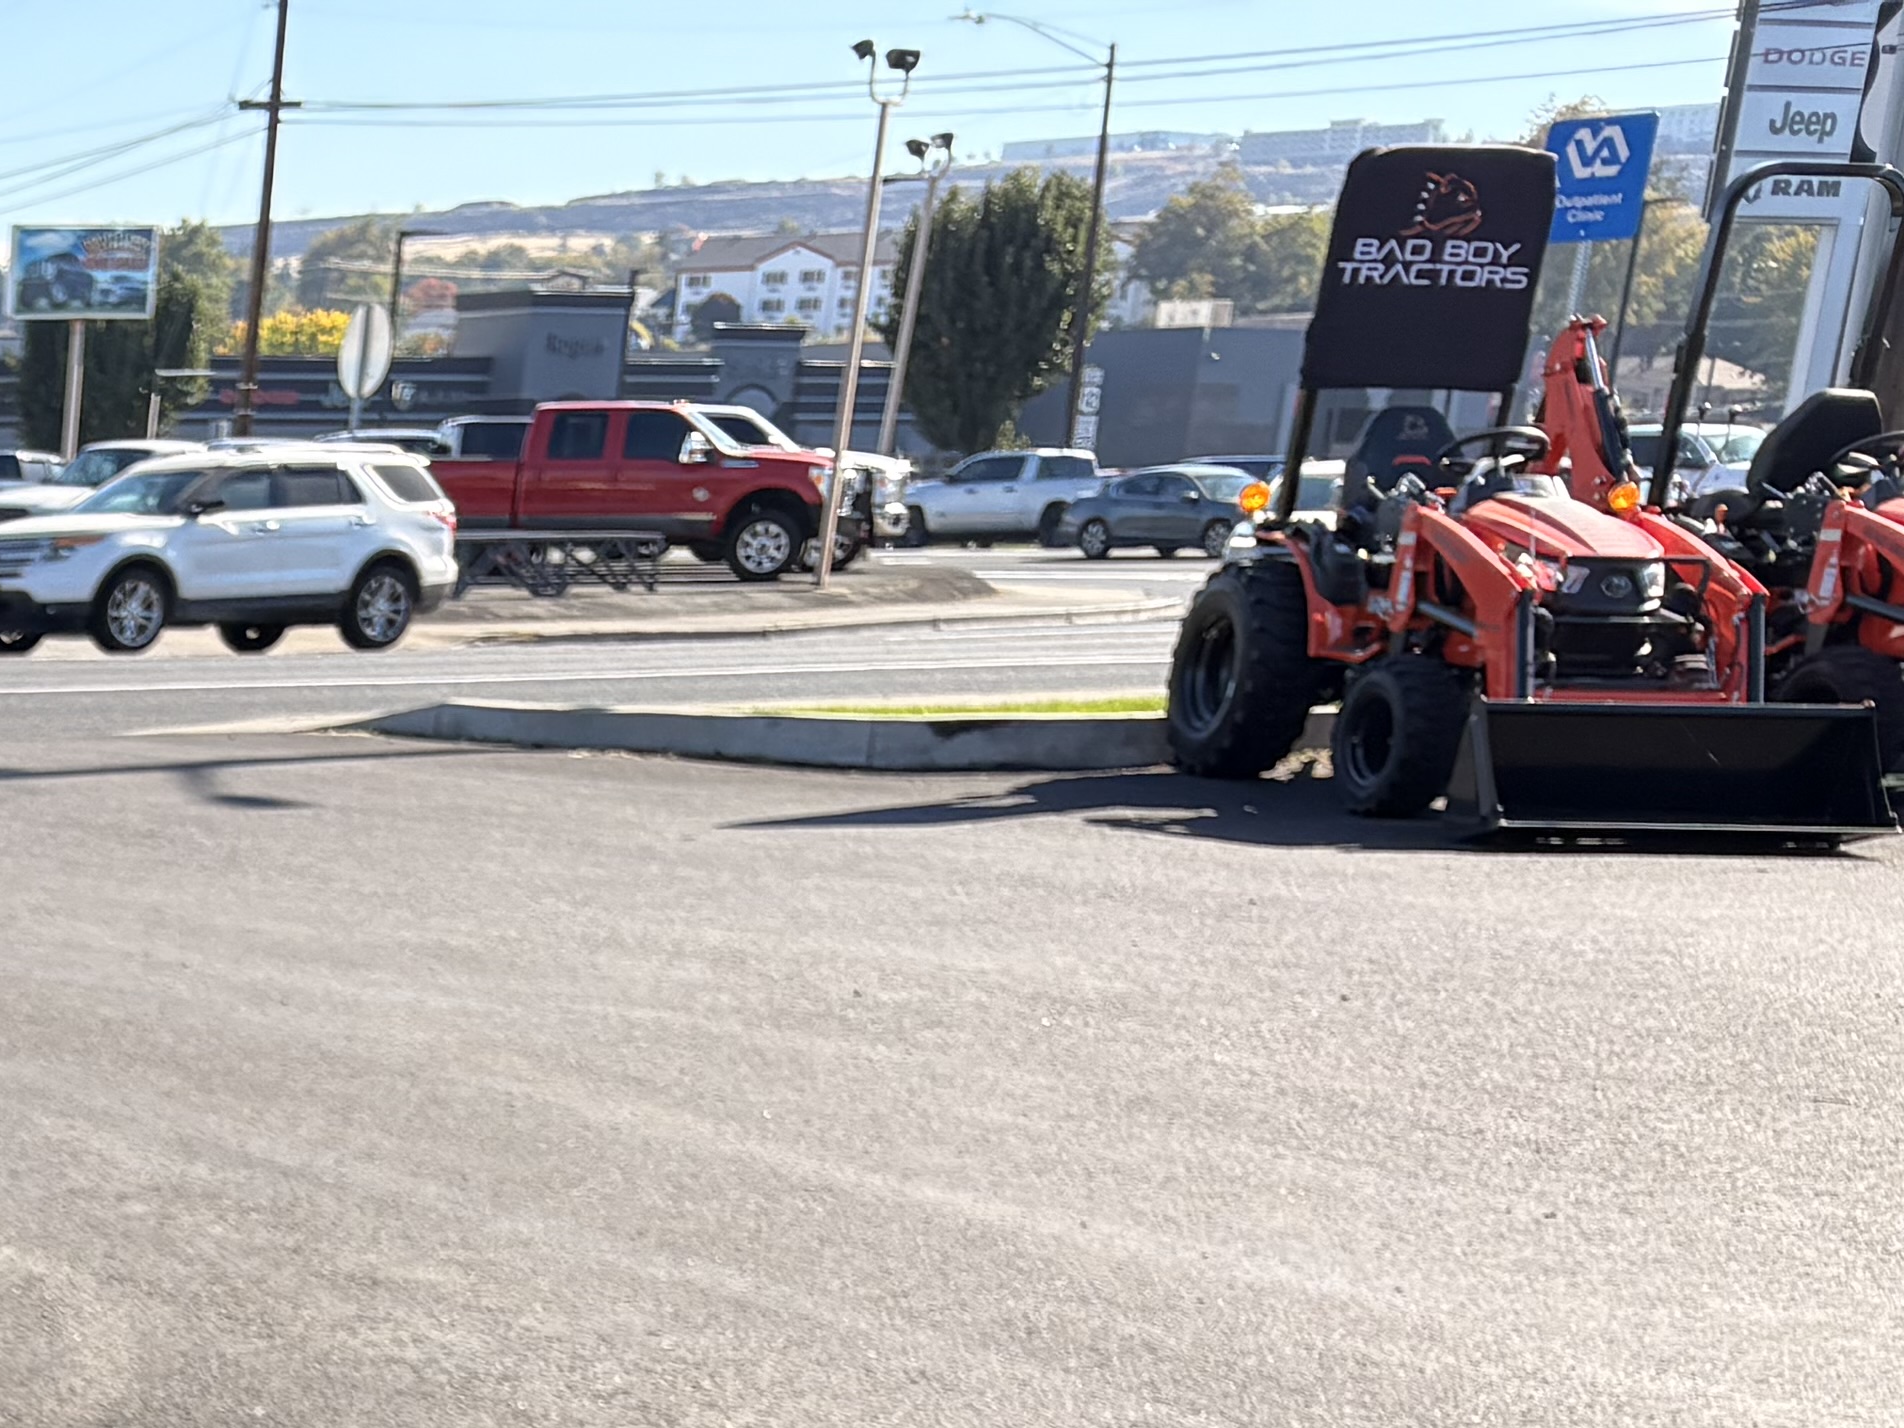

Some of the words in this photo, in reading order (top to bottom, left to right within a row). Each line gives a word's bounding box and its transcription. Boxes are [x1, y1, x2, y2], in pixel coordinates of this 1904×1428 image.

[1761, 47, 1867, 68] DODGE
[1768, 100, 1838, 144] Jeep
[1770, 178, 1842, 198] RAM
[1353, 237, 1433, 262] BAD
[1443, 239, 1522, 265] BOY
[1337, 261, 1530, 290] TRACTORS
